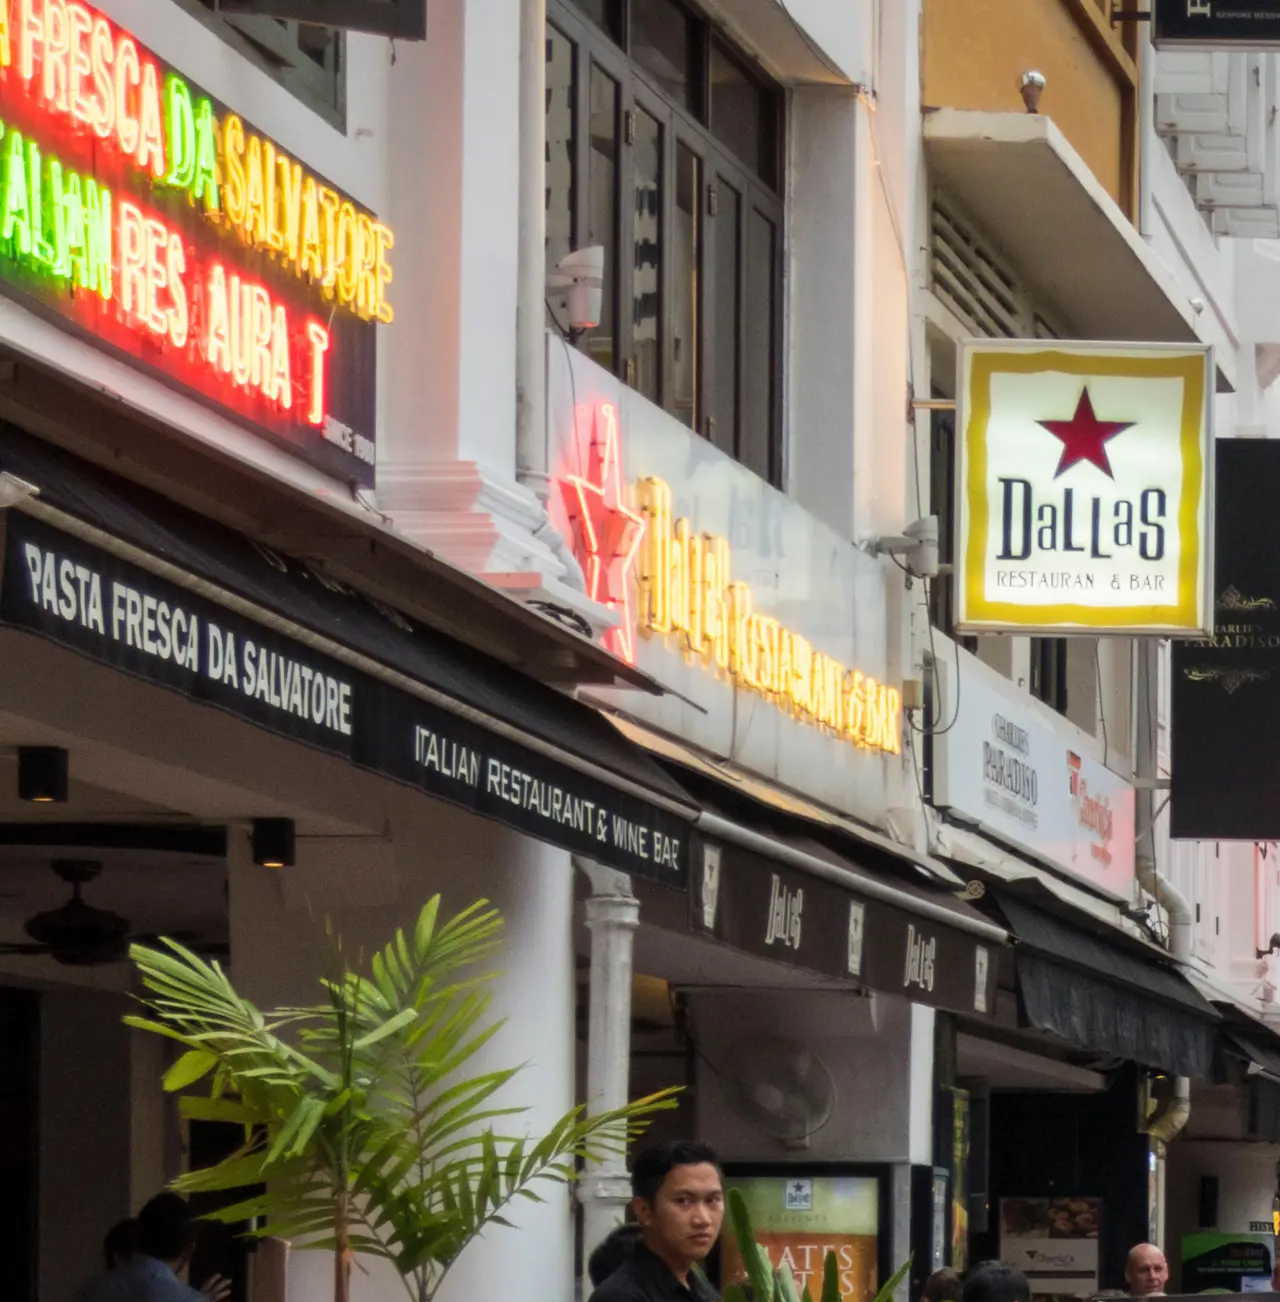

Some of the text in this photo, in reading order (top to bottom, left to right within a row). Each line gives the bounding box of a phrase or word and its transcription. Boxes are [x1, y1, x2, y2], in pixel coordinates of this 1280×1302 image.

[20, 0, 394, 323] FRESCA DA SALVATORE
[24, 542, 352, 736] PASTA FRESCA DA SALVATORE
[1110, 574, 1121, 592] &
[1129, 574, 1165, 591] BAR
[864, 676, 901, 756] BAR
[414, 723, 681, 871] ITALIAN RESTAURANT & WINE BAR
